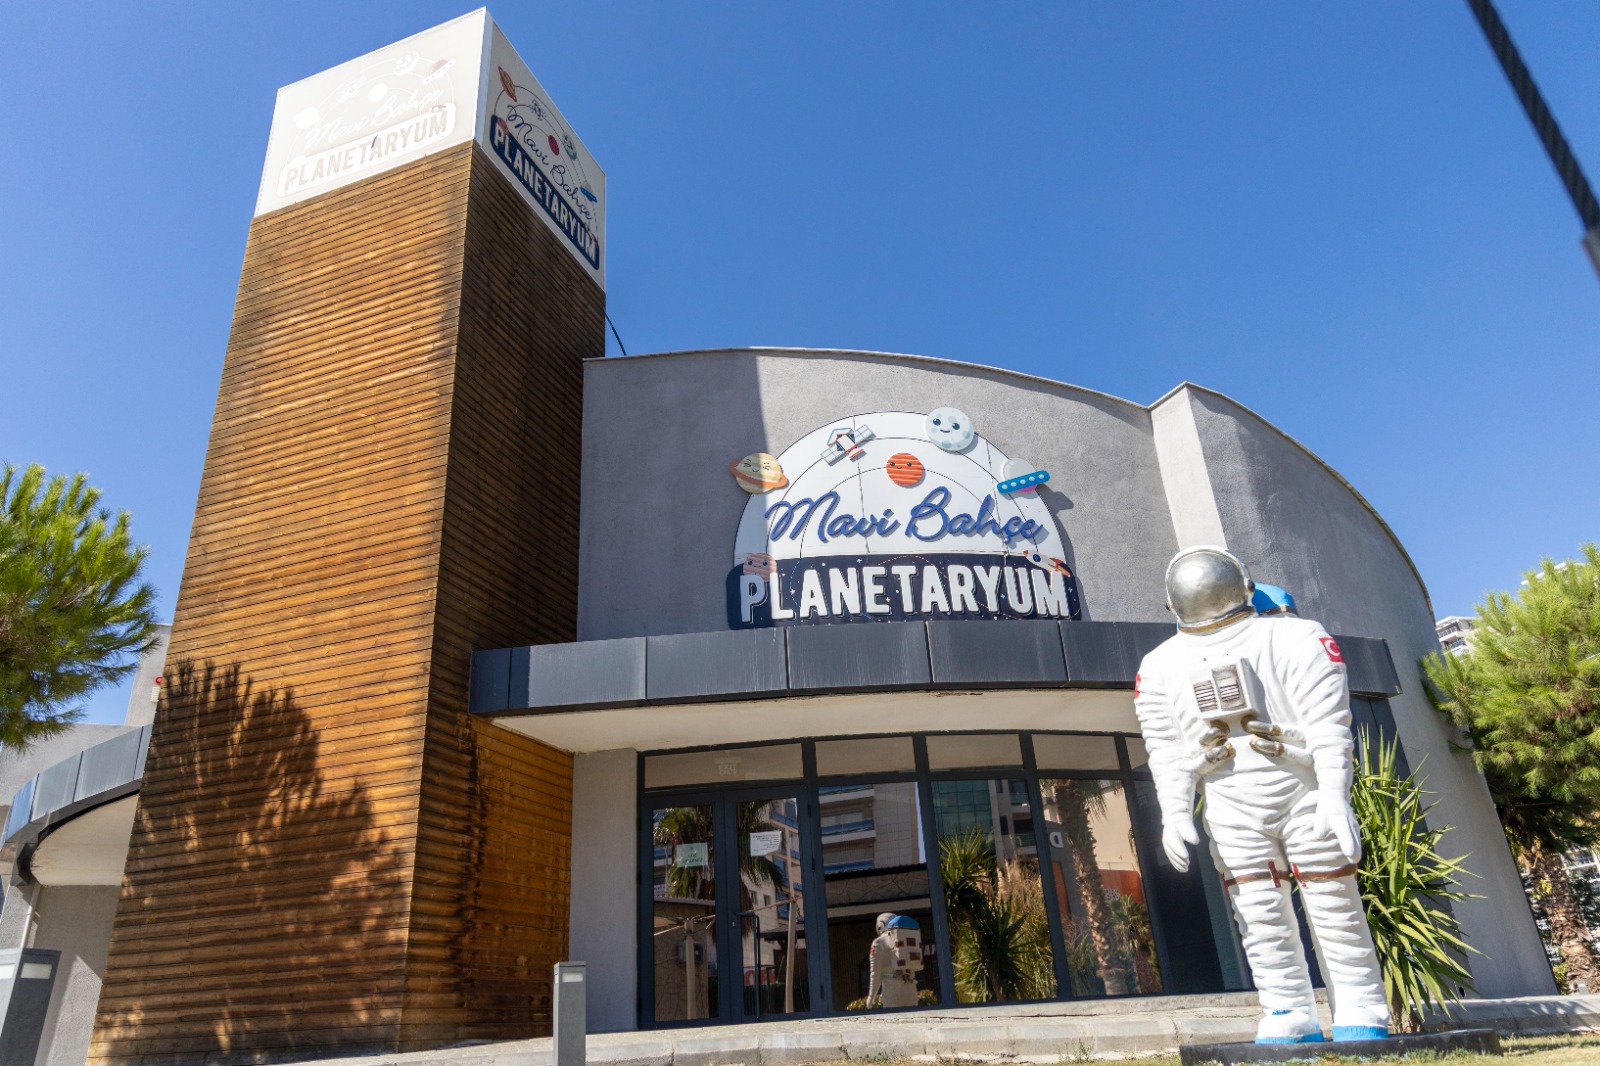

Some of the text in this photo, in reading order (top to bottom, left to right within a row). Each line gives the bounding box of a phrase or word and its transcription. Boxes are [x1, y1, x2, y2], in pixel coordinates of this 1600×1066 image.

[283, 109, 447, 192] PLANETARYUM
[304, 116, 369, 149] Mavi
[506, 103, 592, 220] Mavi Bahçe
[494, 120, 596, 262] PLANETARYUM
[764, 486, 1045, 542] Mavi Bahçe
[740, 564, 1070, 623] PLANETARYUM
